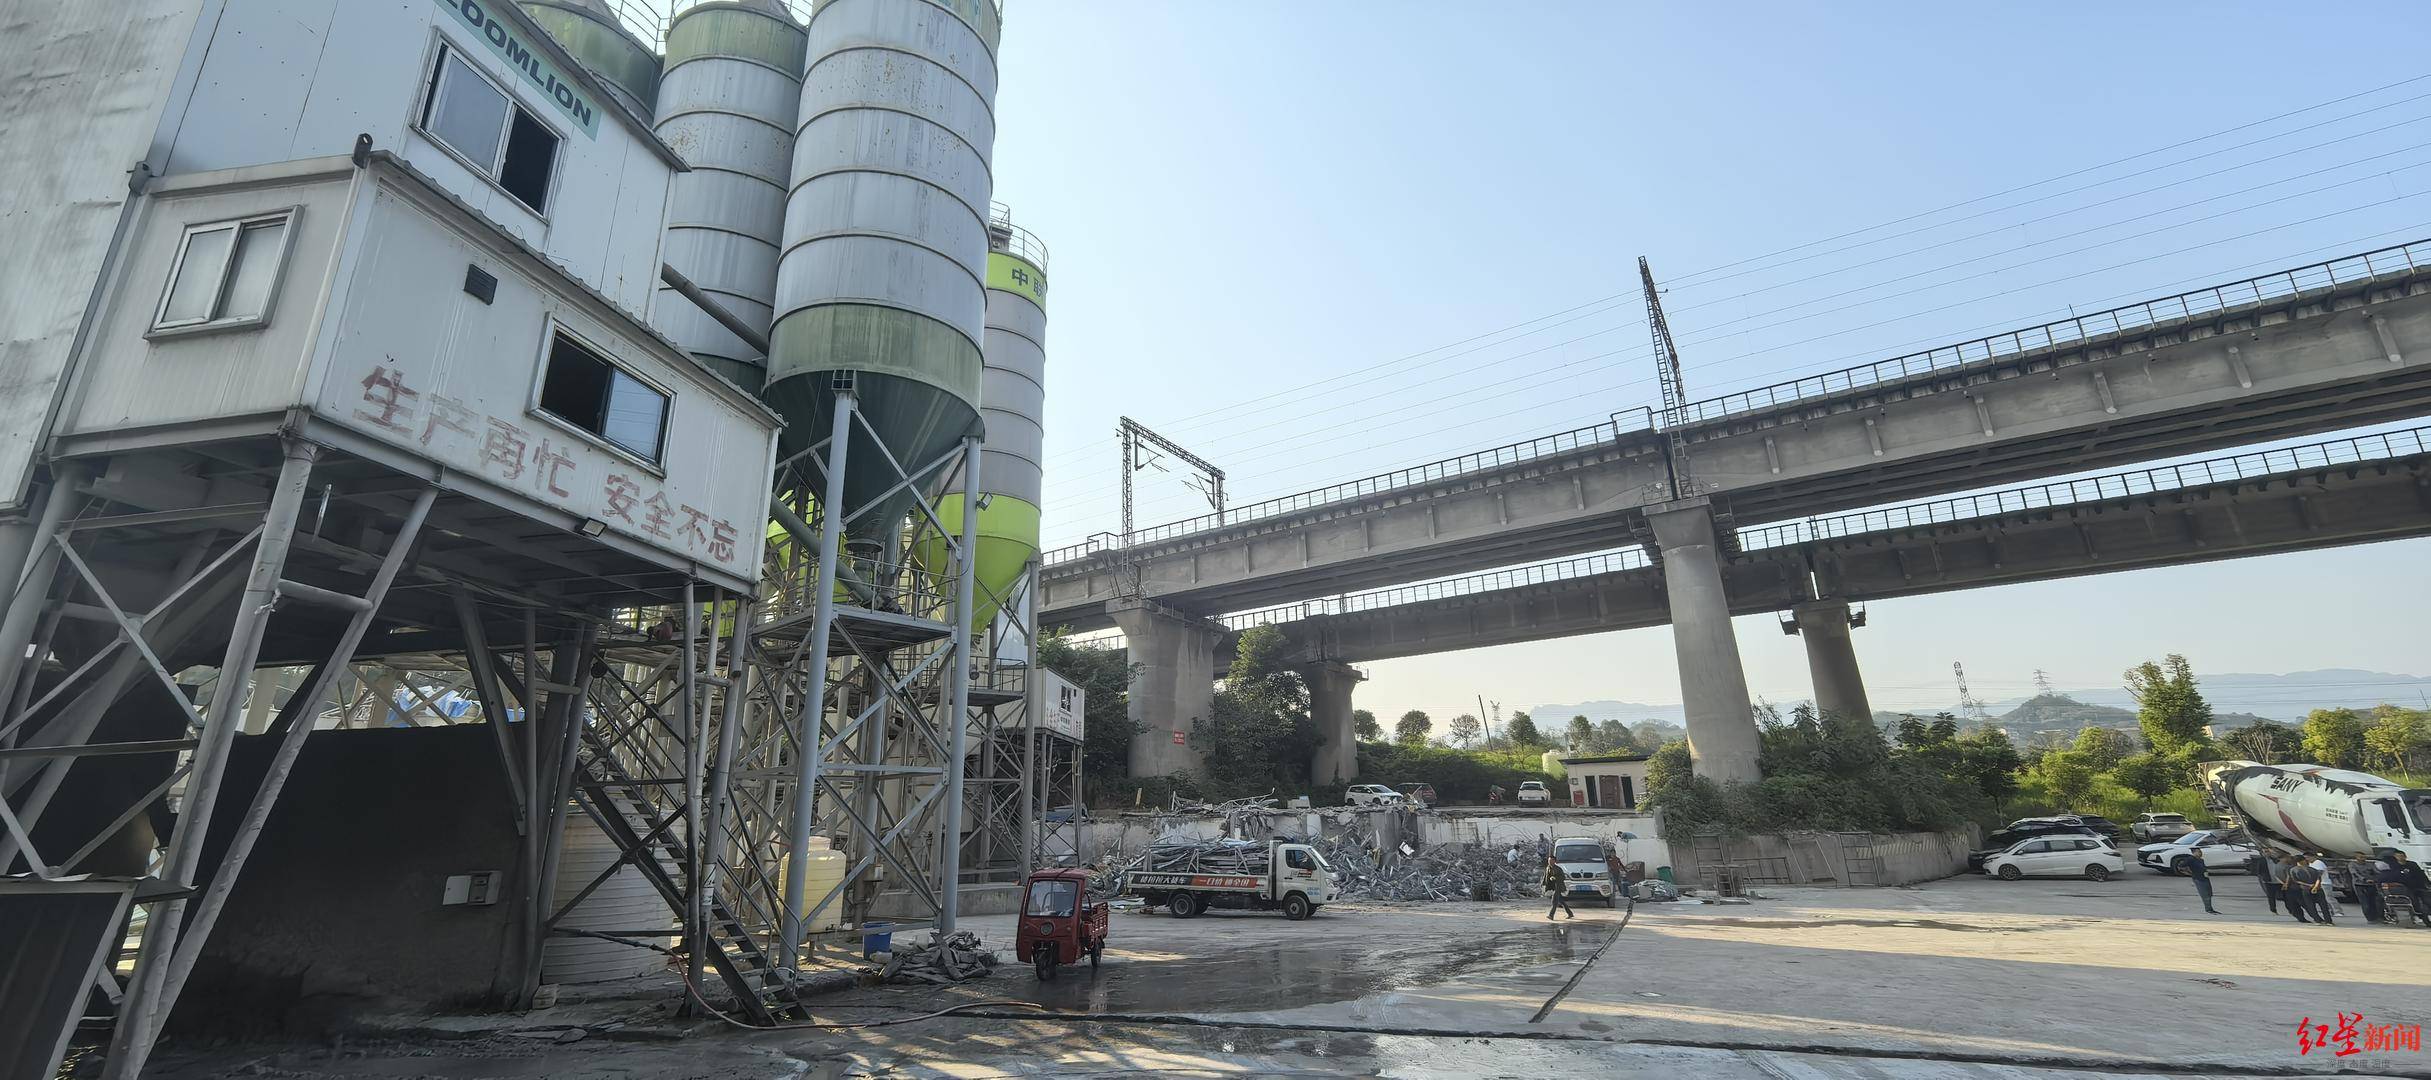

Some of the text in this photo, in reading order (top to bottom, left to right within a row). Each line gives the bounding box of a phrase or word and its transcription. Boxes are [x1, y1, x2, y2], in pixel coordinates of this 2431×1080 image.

[353, 366, 739, 563] 生产再忙 安全不忘
[2270, 777, 2304, 793] SANY
